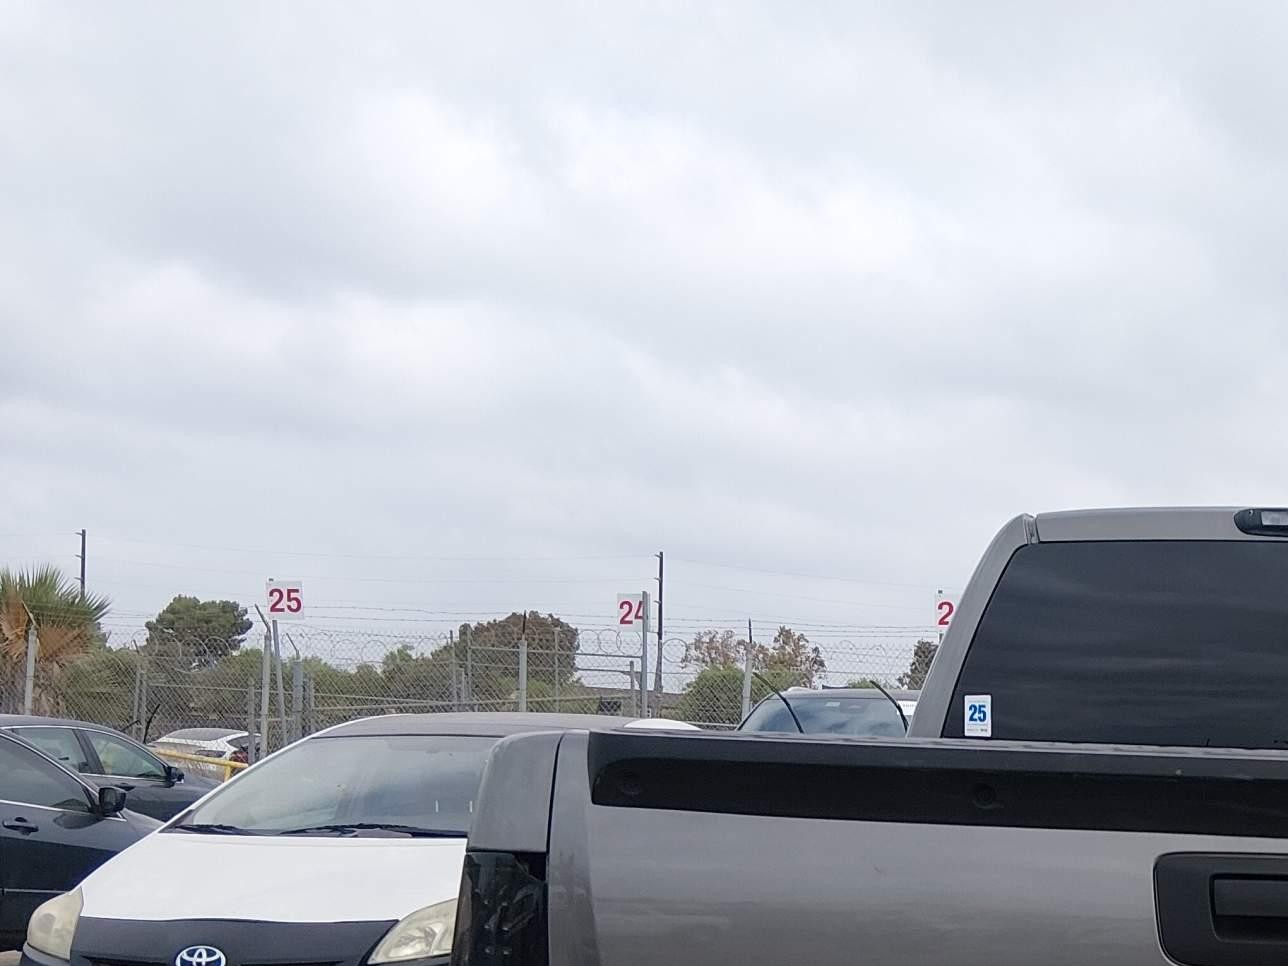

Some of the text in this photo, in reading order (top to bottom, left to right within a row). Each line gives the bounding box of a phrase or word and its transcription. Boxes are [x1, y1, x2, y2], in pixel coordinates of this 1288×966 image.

[269, 588, 302, 613] 25
[937, 601, 954, 626] 2
[968, 703, 987, 722] 25
